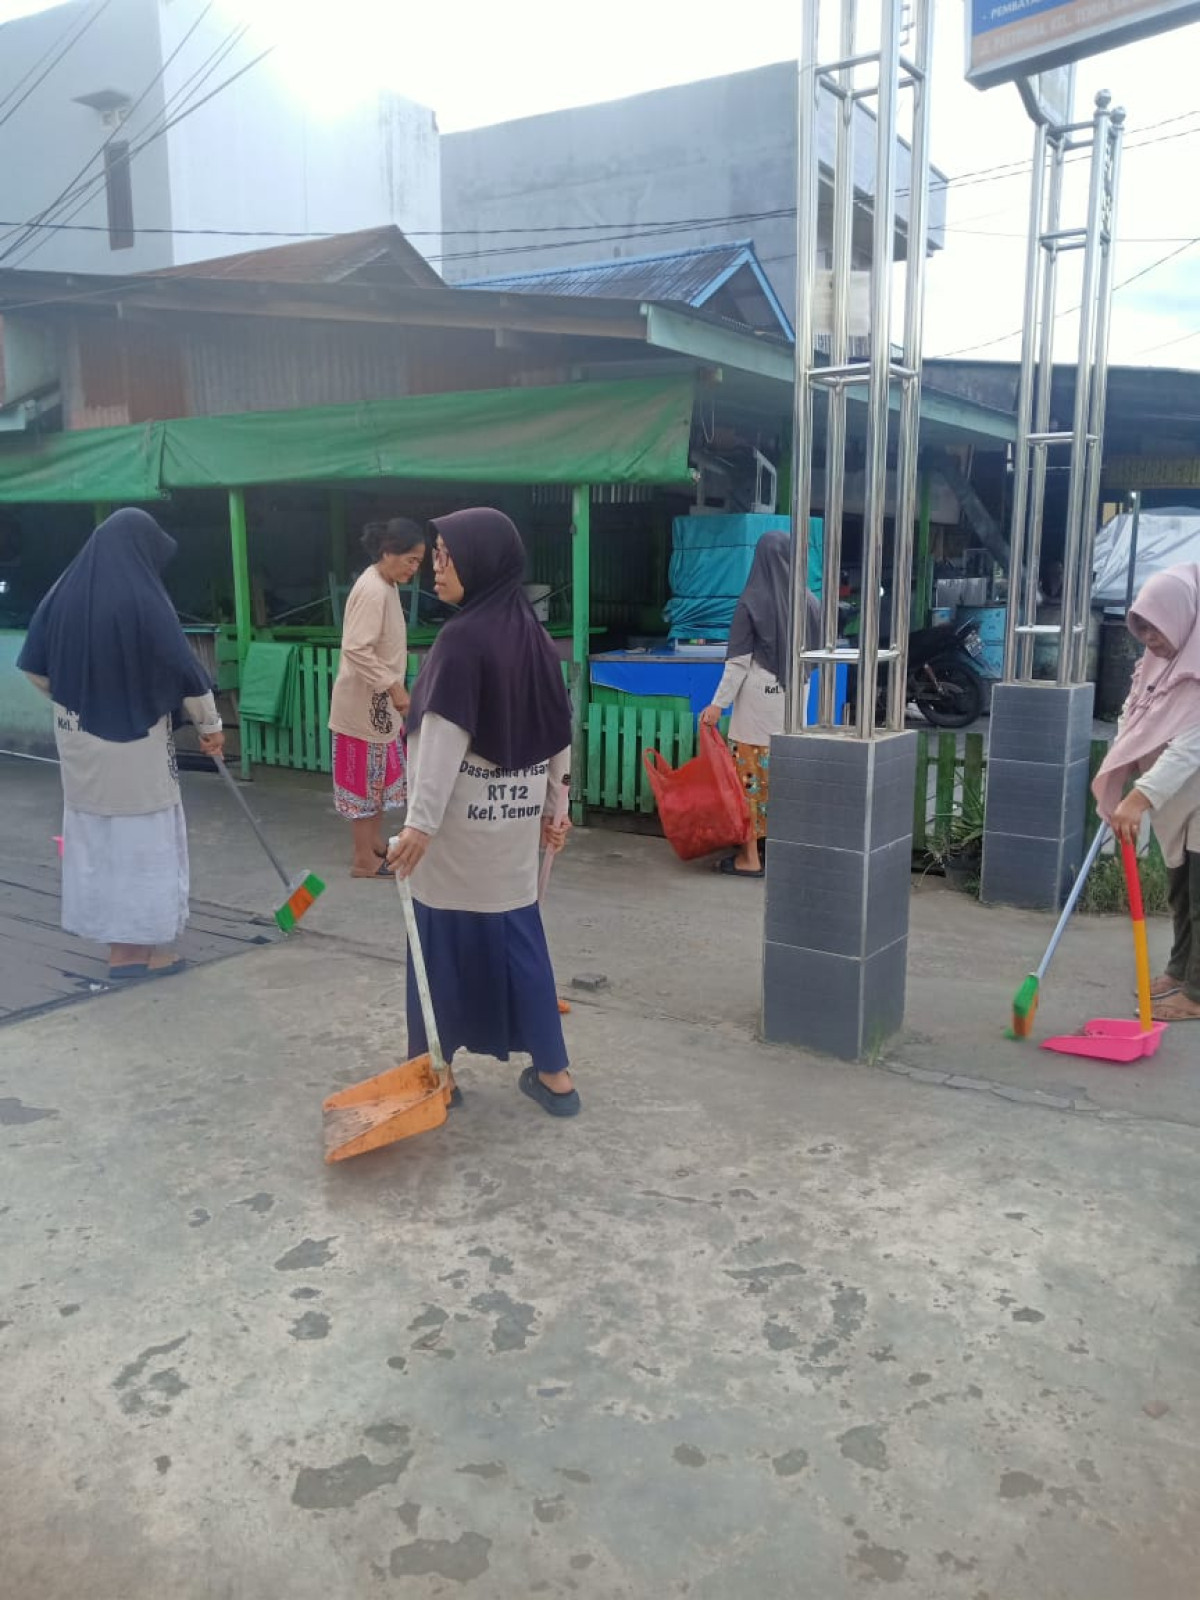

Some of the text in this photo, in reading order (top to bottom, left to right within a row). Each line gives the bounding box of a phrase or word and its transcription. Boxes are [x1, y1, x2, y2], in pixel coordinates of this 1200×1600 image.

[488, 784, 529, 801] RT 12
[467, 803, 497, 821] Kel.
